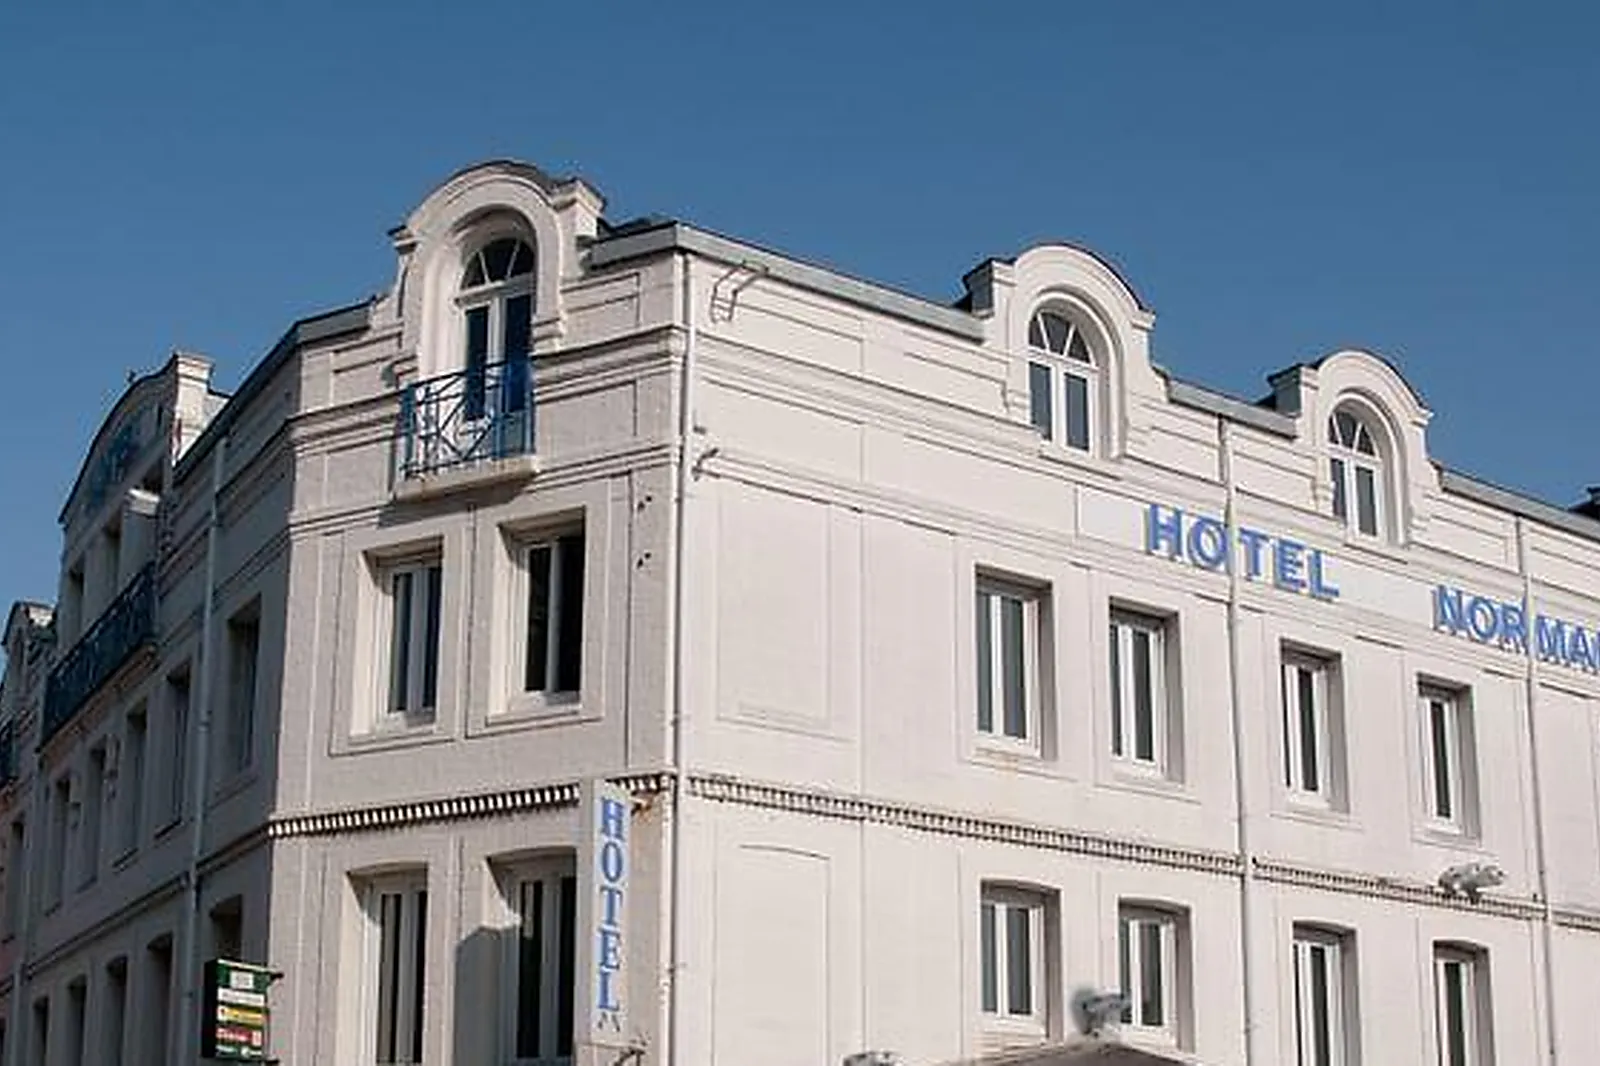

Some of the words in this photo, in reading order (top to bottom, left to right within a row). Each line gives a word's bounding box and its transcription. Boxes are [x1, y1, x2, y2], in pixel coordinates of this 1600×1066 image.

[1146, 503, 1339, 600] HOTEL
[1434, 584, 1600, 670] NORMA
[598, 796, 625, 1012] HOTEL
